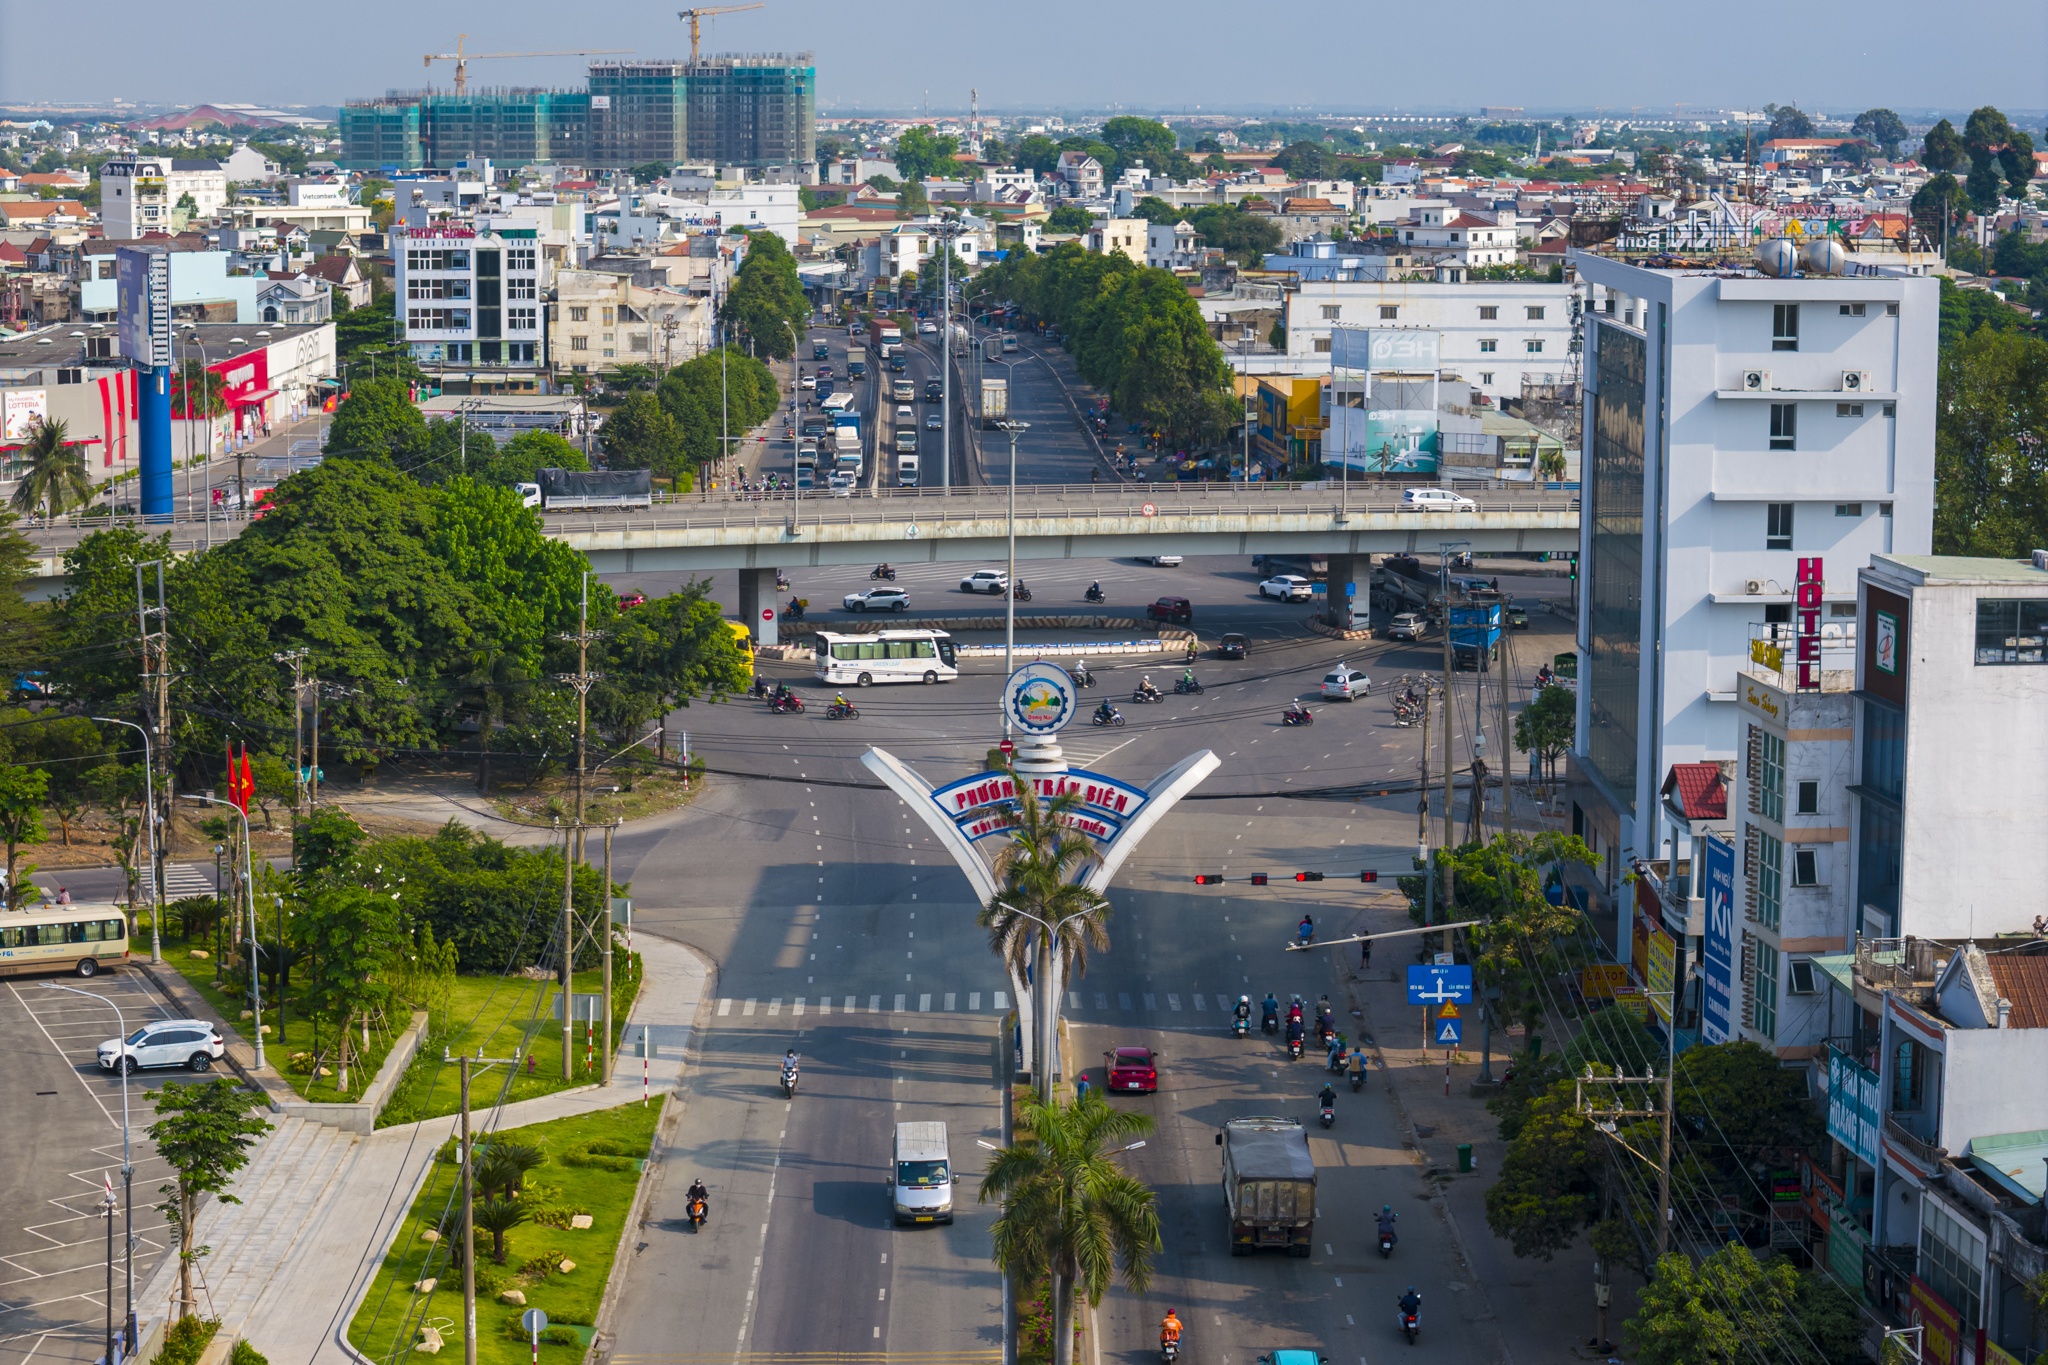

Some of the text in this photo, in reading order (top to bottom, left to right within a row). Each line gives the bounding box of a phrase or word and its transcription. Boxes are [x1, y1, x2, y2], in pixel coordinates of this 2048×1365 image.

[442, 228, 476, 239] GIANG
[1798, 557, 1823, 688] HOTEL
[1032, 775, 1081, 798] TRẤN
[1085, 785, 1129, 813] BIÊN
[993, 813, 1022, 830] NH
[1711, 886, 1732, 945] Ki
[1829, 1096, 1857, 1140] HOÀNG
